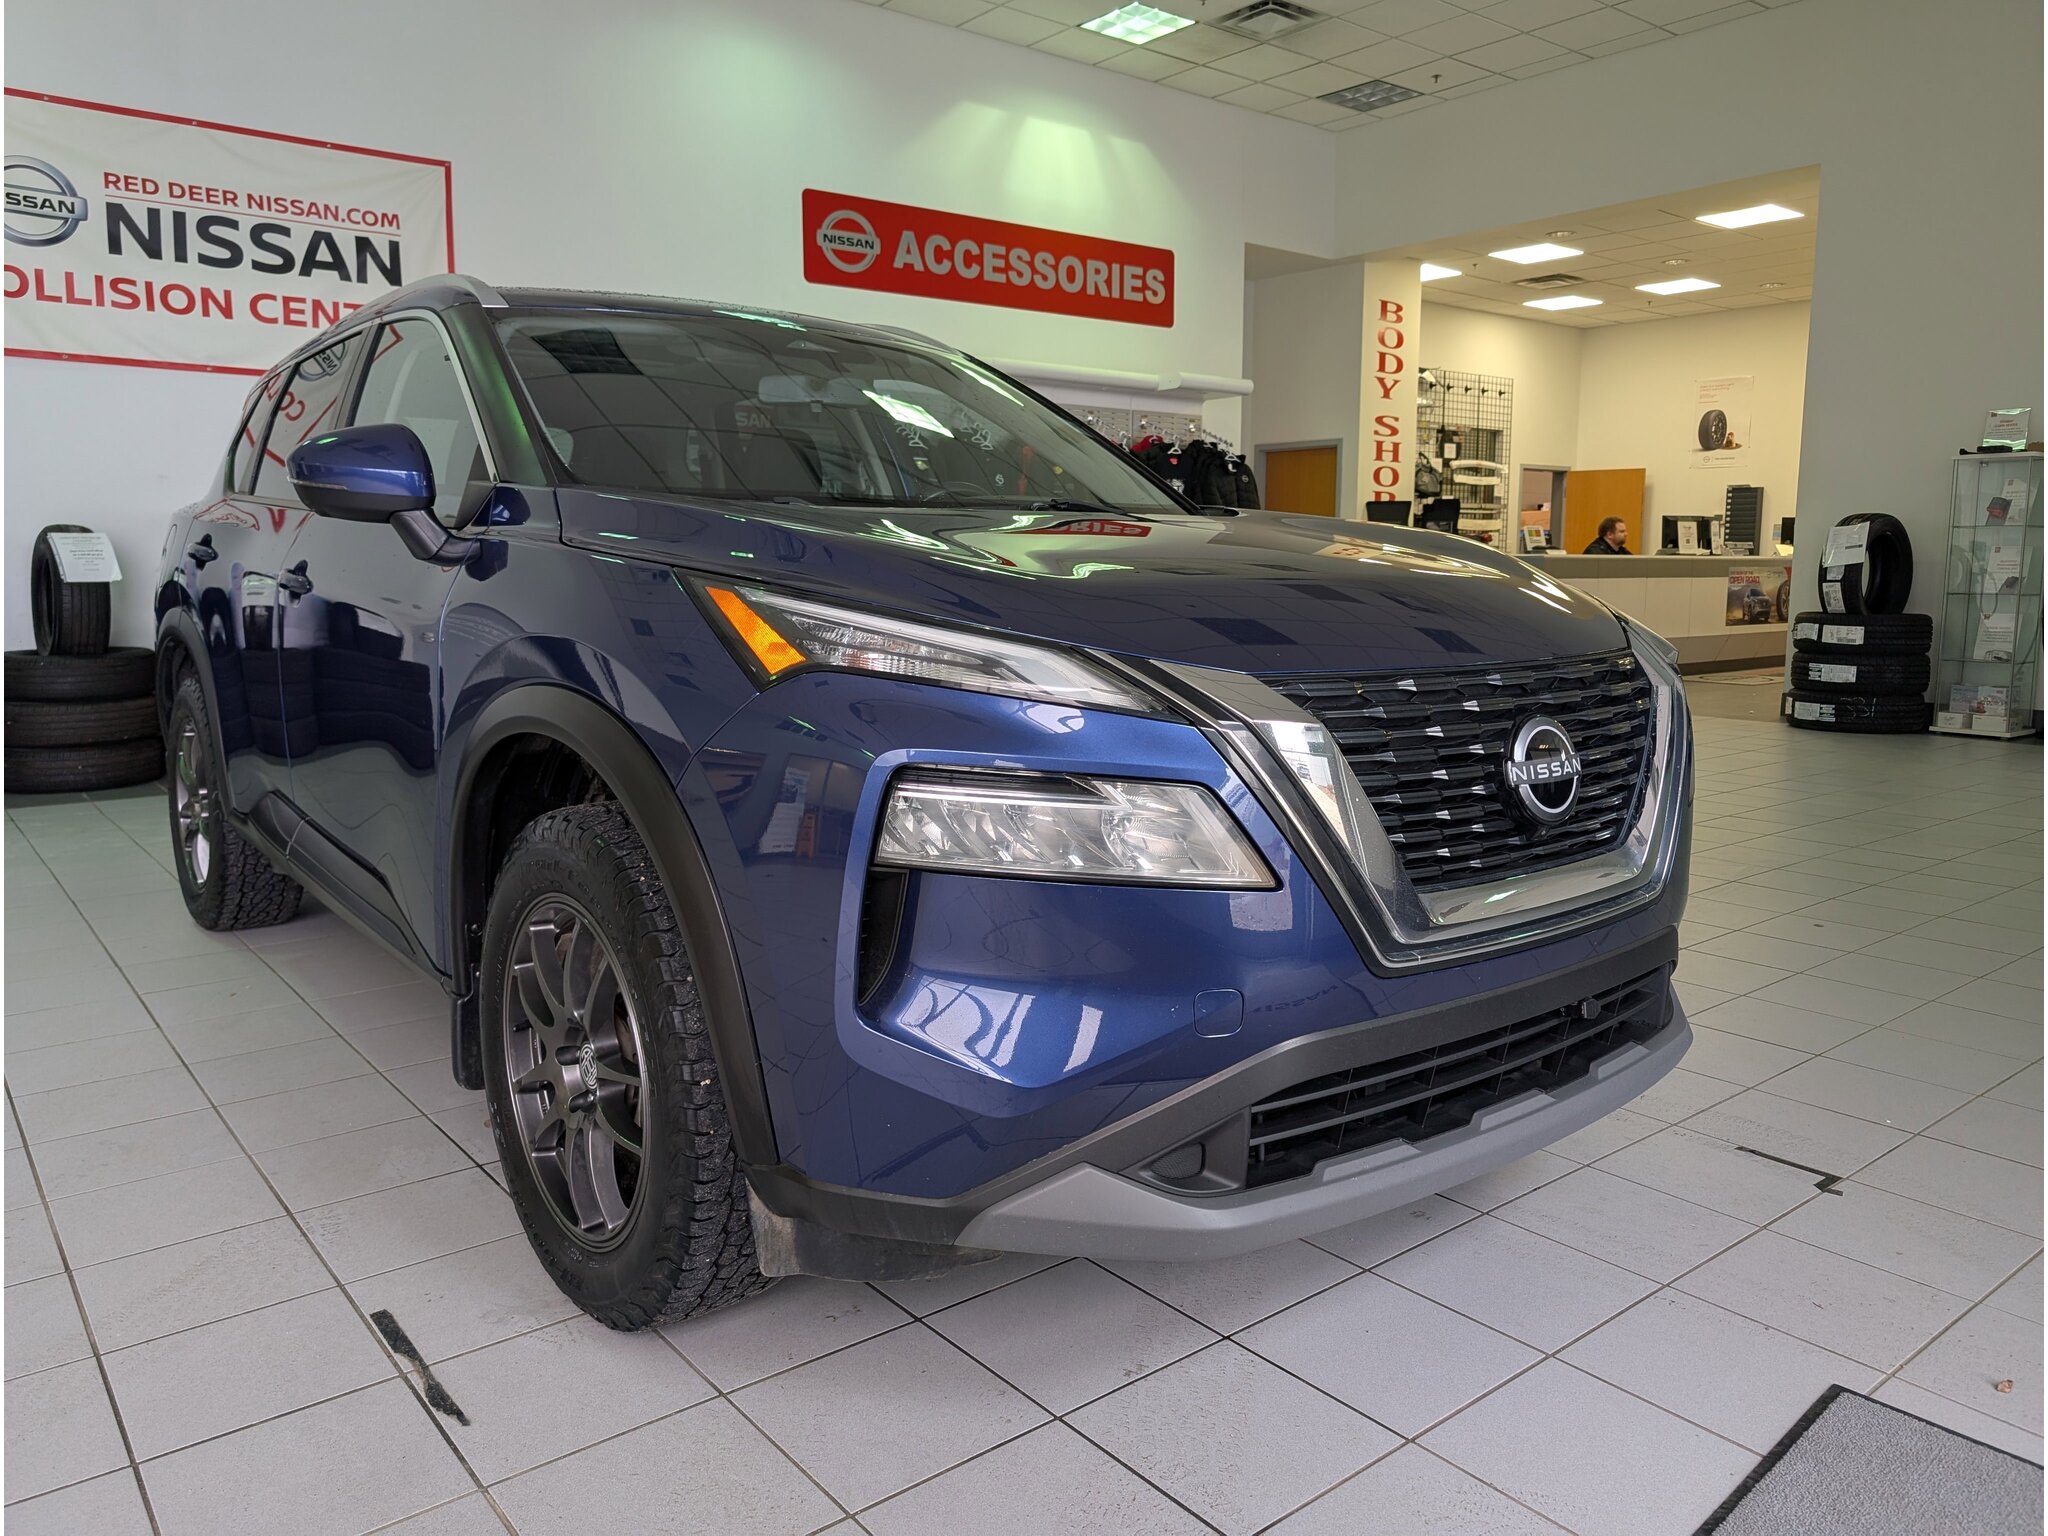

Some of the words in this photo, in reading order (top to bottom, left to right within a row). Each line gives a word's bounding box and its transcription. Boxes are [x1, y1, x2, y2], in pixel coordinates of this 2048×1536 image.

[103, 172, 160, 195] RED
[168, 181, 239, 207] DEER
[246, 193, 400, 230] NISSAN.COM
[105, 202, 402, 287] NISSAN
[822, 232, 875, 251] NISSAN
[893, 230, 1166, 305] ACCESSORIES
[1374, 299, 1404, 400] BODY
[1511, 757, 1581, 781] NISSAN
